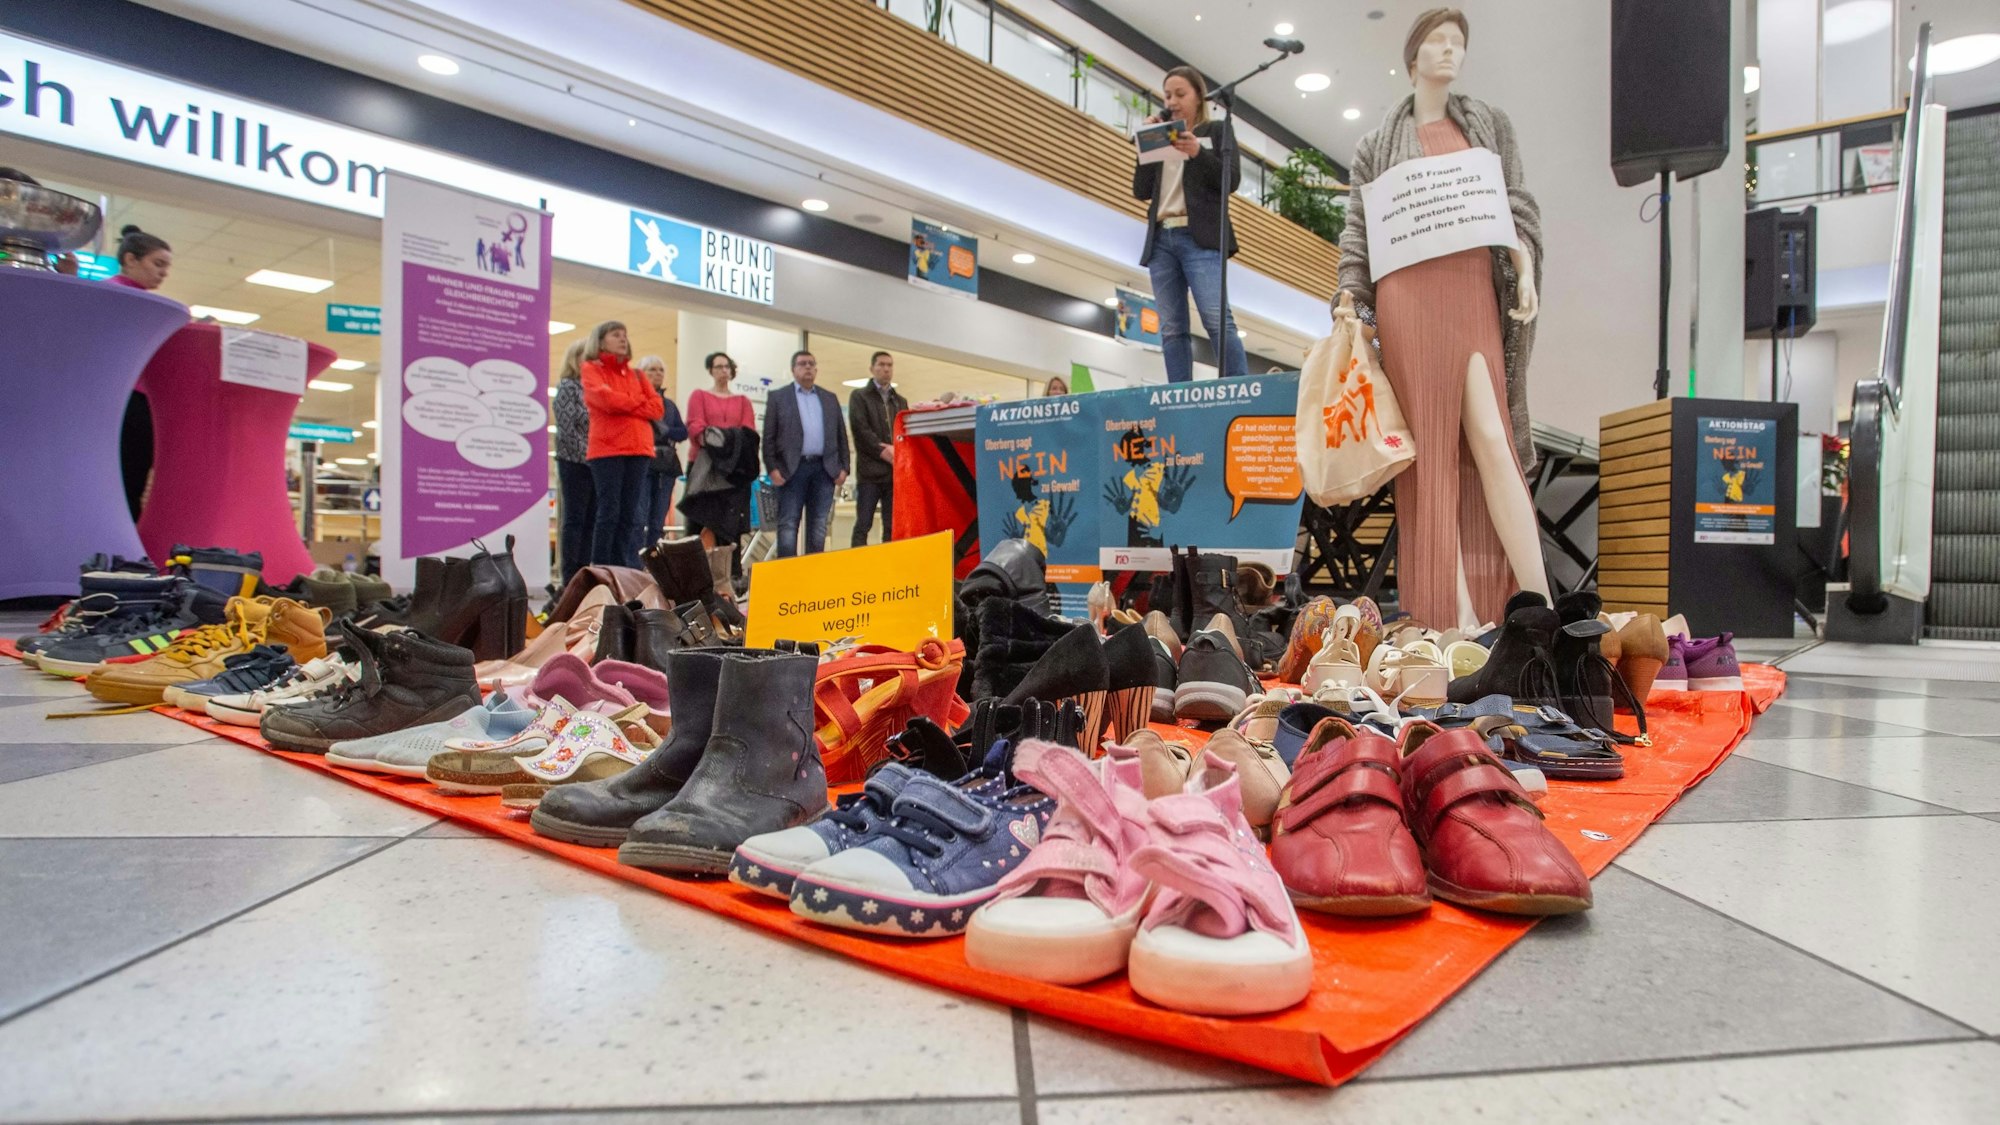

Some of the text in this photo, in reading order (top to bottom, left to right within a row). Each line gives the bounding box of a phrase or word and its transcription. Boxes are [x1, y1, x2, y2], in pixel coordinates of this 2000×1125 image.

[109, 97, 386, 199] willkom
[1405, 166, 1462, 182] 155 Frauen
[1392, 174, 1482, 202] sind im Jahr 2023
[1381, 187, 1497, 222] durch häusliche Gewalt
[1413, 203, 1466, 223] gestorben
[1390, 212, 1497, 245] Das sind ihre Schuhe
[706, 231, 772, 273] BRUNO
[705, 262, 772, 303] KLEINE
[735, 383, 758, 393] TOM
[1149, 382, 1262, 406] AKTIONSTAG
[989, 400, 1080, 422] AKTIONSTAG
[1139, 416, 1157, 431] sagt
[1708, 420, 1766, 431] AKTIONSTAG
[1112, 434, 1176, 462] NEIN
[1165, 452, 1205, 466] zu Gewalt!
[1712, 445, 1757, 460] NEIN
[998, 449, 1068, 481] NEIN
[1041, 478, 1080, 493] zu Gewalt!
[778, 584, 920, 617] Schauen Sie nicht
[823, 612, 871, 633] weg!!!
